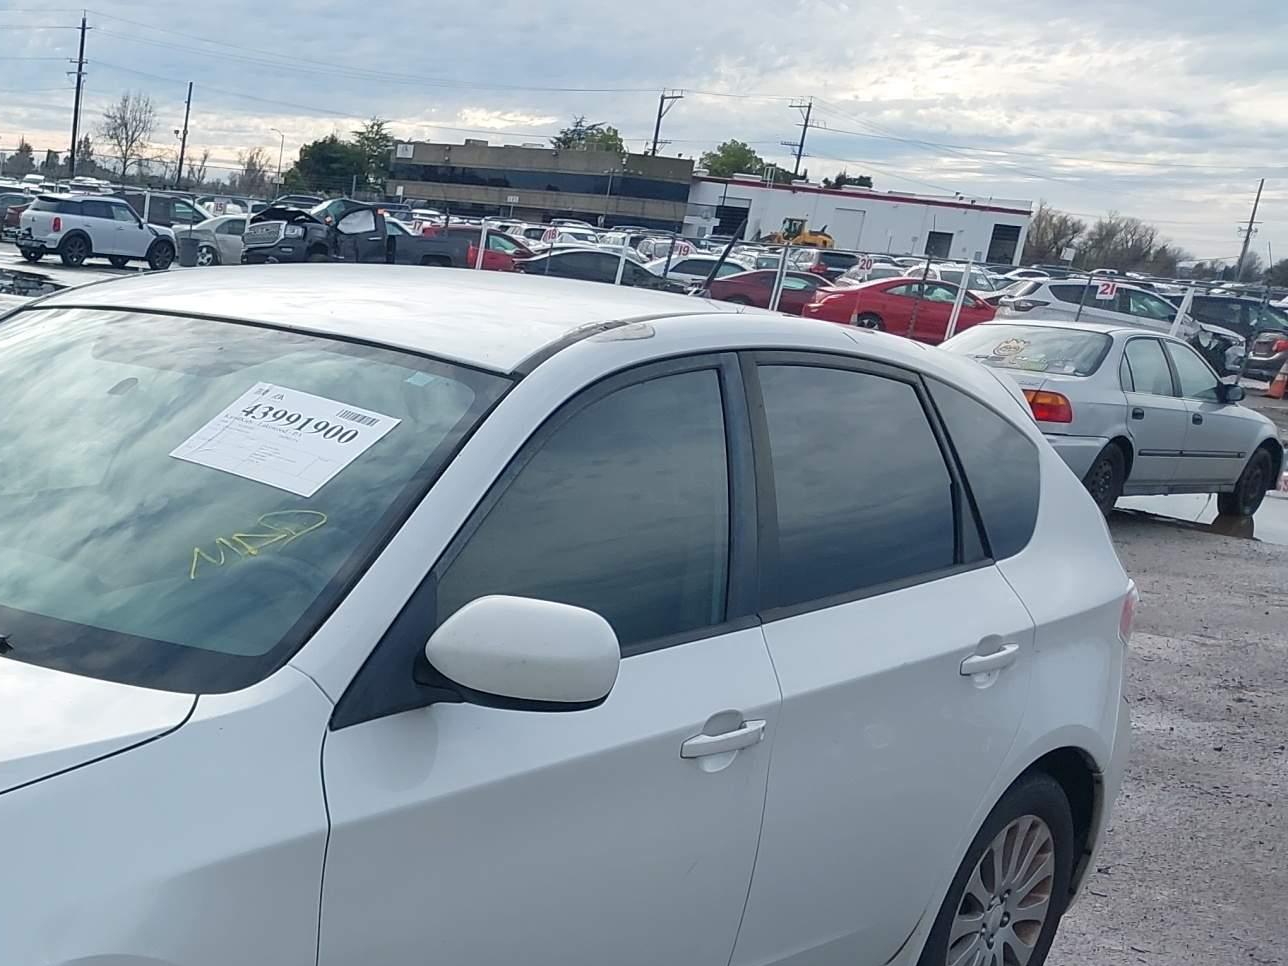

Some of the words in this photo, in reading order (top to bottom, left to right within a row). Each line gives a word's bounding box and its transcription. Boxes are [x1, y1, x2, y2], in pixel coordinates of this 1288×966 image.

[678, 245, 690, 256] 19
[859, 258, 872, 270] 20
[1099, 283, 1116, 296] 21
[241, 403, 359, 443] 43991900
